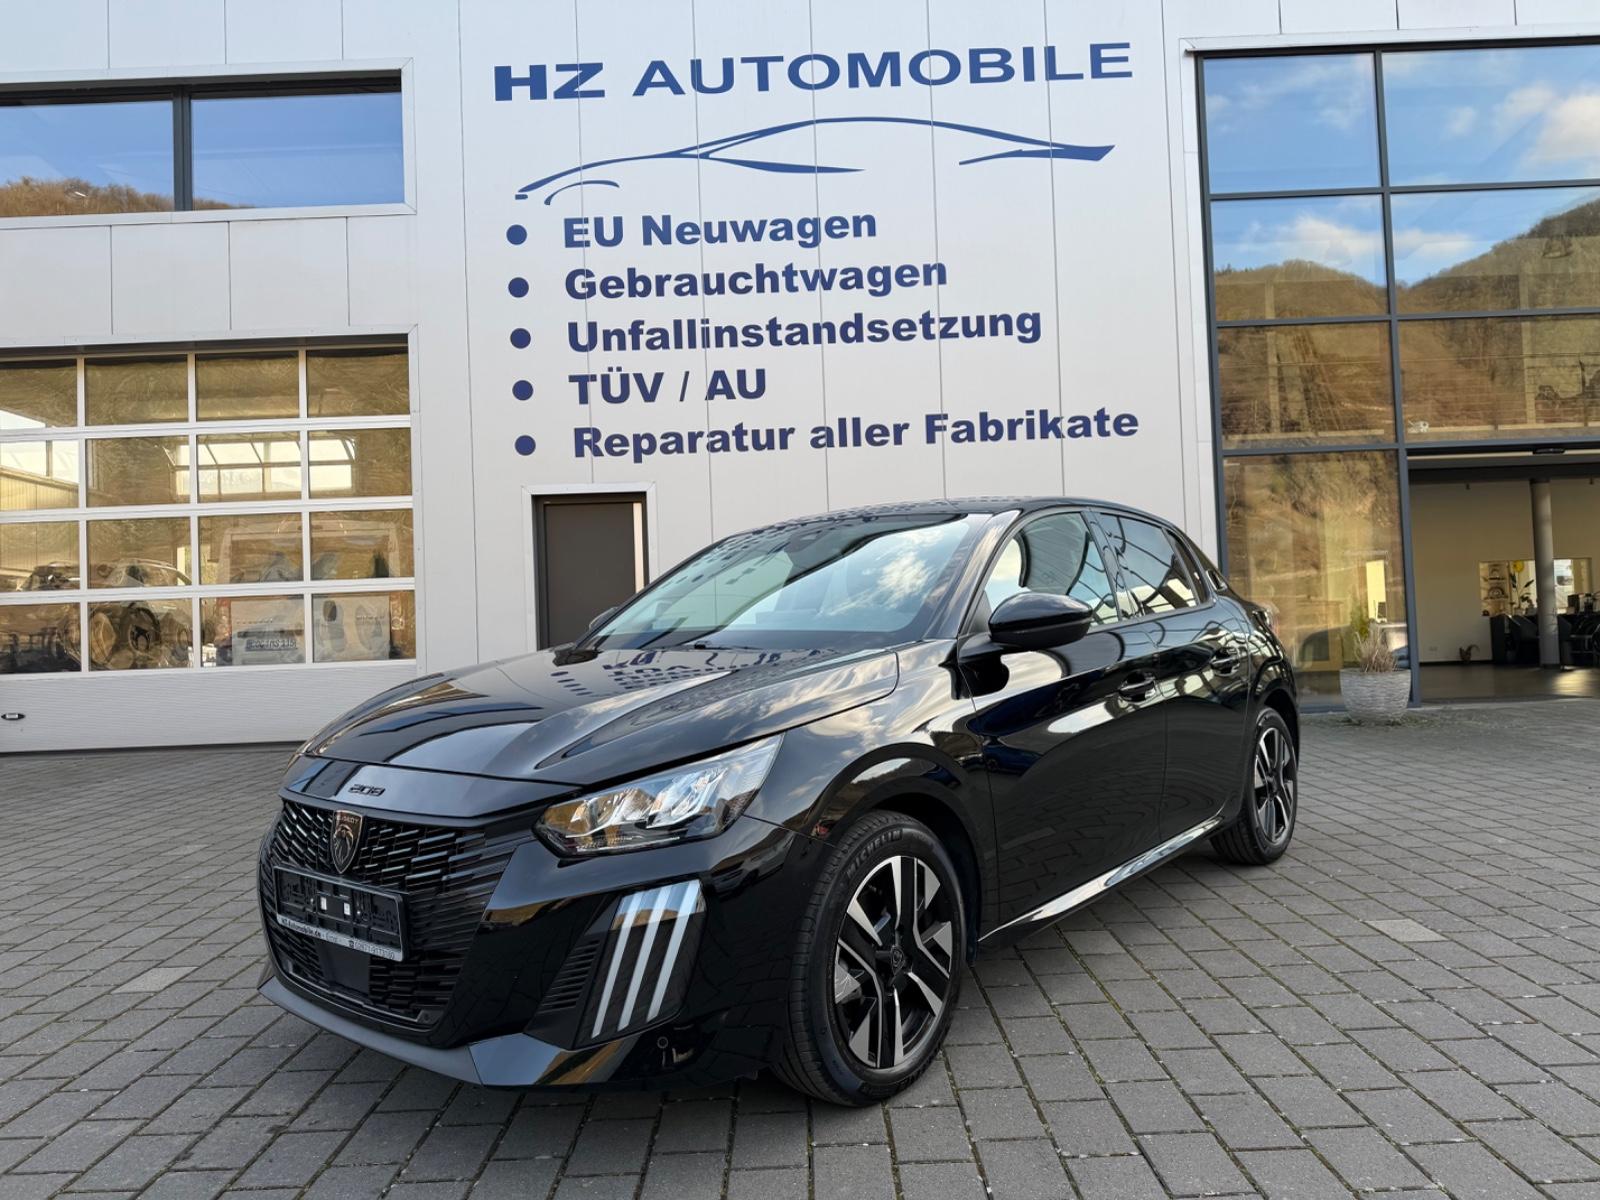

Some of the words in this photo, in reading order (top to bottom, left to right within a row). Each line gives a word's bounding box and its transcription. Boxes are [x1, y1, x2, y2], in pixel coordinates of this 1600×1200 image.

[494, 62, 606, 102] HZ
[633, 42, 1133, 97] AUTOMOBILE
[563, 215, 624, 249] EU
[642, 214, 877, 249] Neuwagen
[564, 262, 947, 301] Gebrauchtwagen
[568, 310, 1042, 353] Unfallinstandsetzung
[568, 366, 665, 405] TÜV
[679, 370, 690, 403] /
[705, 368, 766, 401] AU
[574, 426, 796, 464] Reparatur
[809, 416, 911, 450] aller
[924, 407, 1139, 445] Fabrikate
[348, 783, 386, 797] 208
[846, 829, 902, 879] MICHELIN
